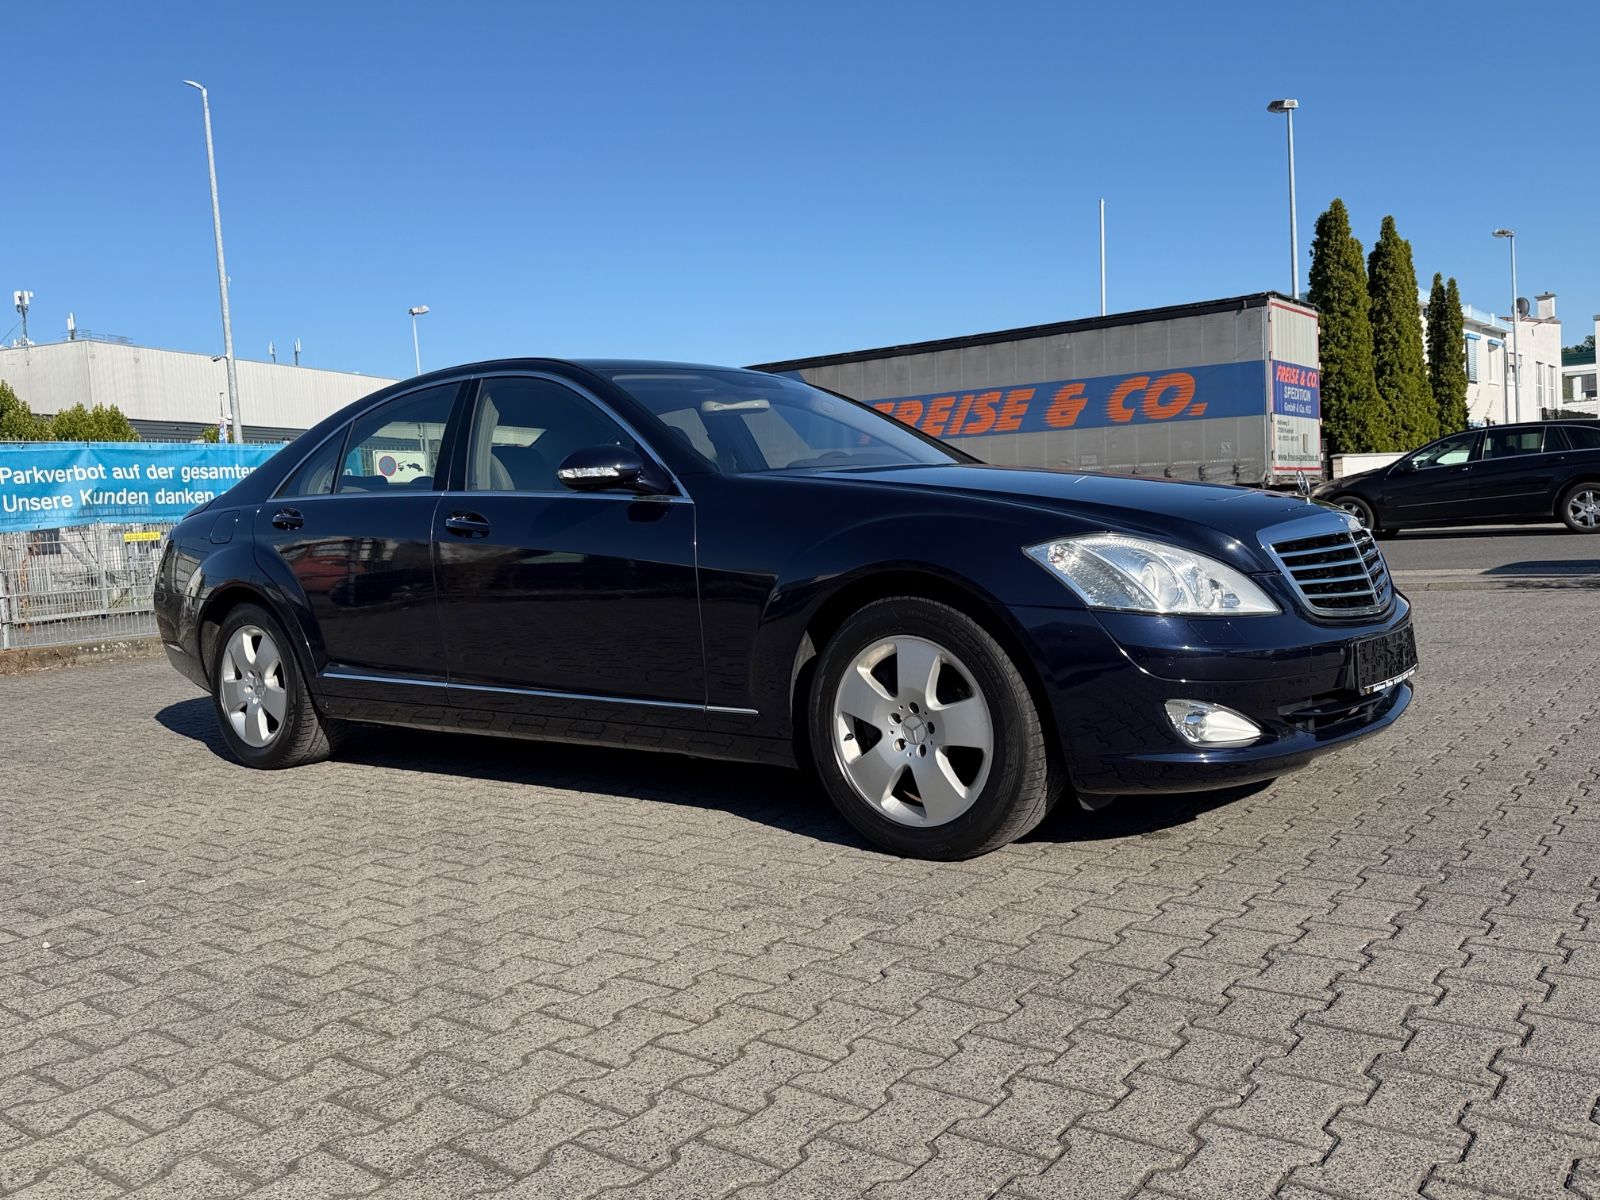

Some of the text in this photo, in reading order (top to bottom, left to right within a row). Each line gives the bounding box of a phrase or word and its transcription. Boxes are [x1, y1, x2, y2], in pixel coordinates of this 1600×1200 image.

[1276, 365, 1299, 384] FREISE
[1300, 370, 1306, 386] &
[1044, 383, 1089, 428] &
[1107, 372, 1208, 422] CO.
[1284, 386, 1311, 402] SPEDITION
[1284, 402, 1296, 412] GmbH
[0, 464, 109, 484] Parkverbot
[112, 464, 141, 480] auf
[146, 464, 174, 480] der
[3, 488, 215, 512] Unsere Kunden danken
